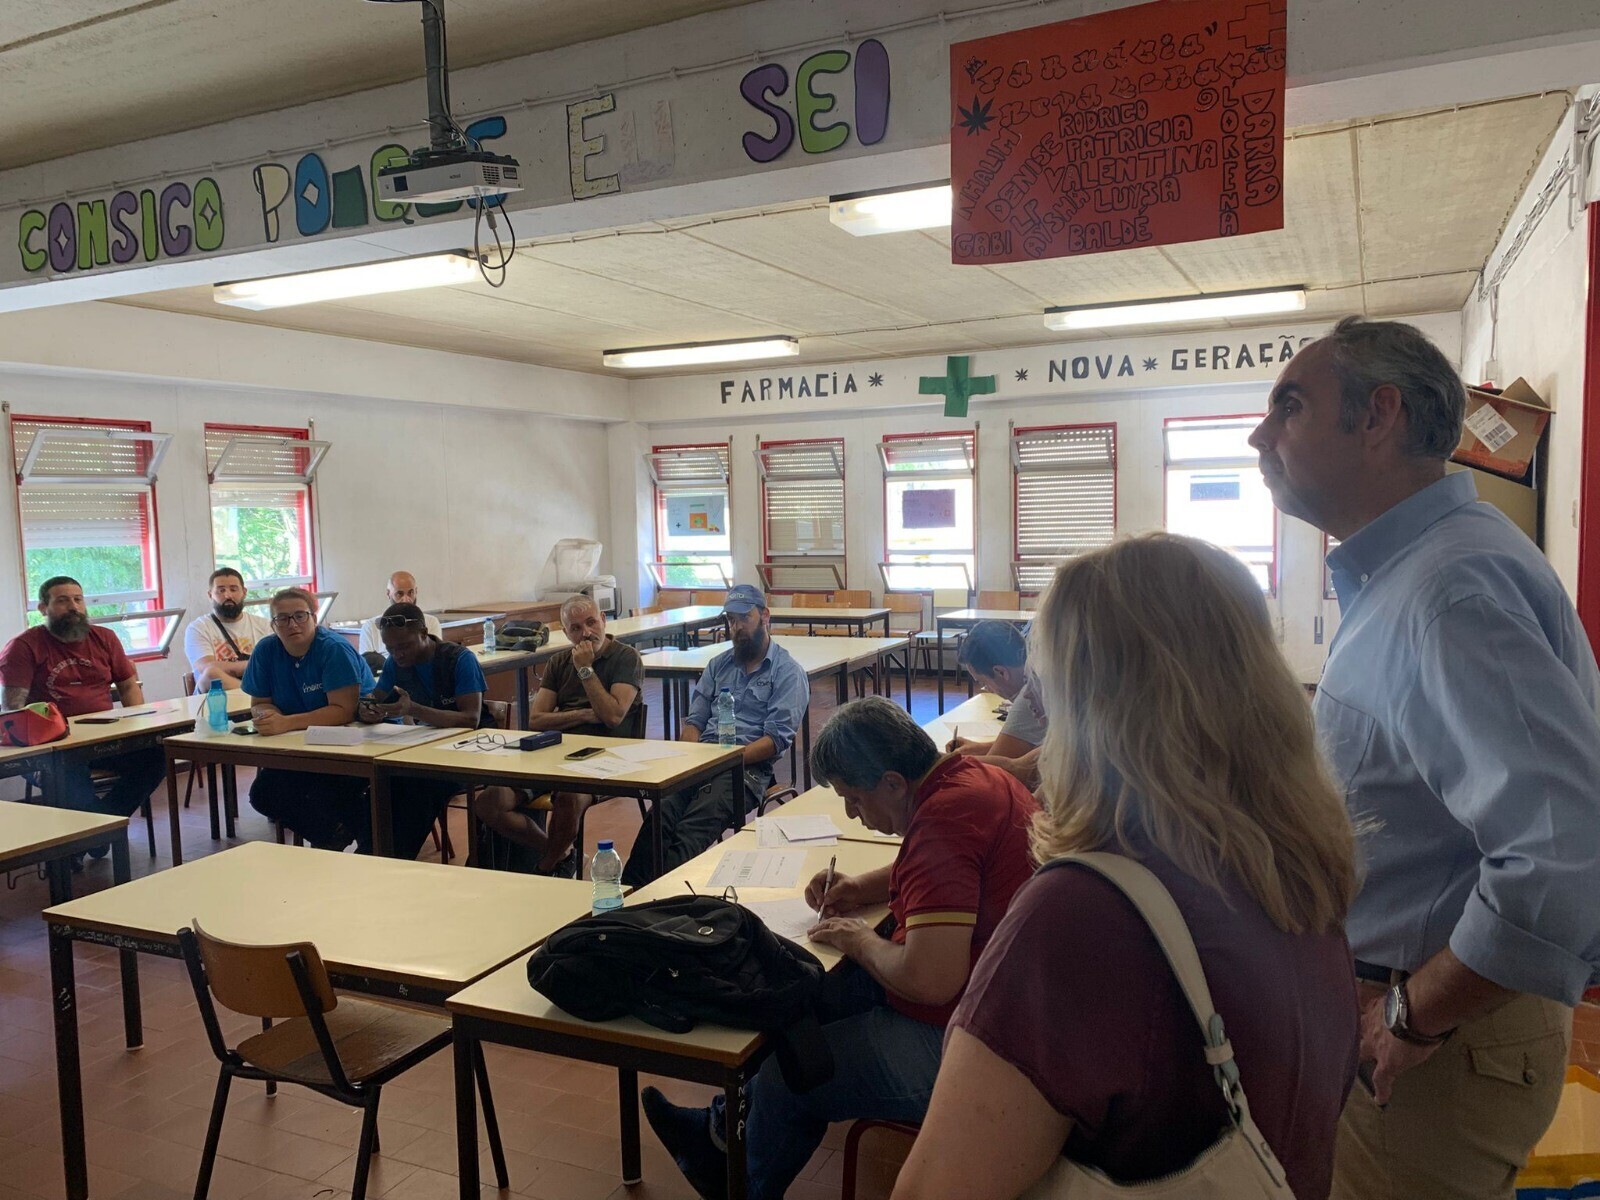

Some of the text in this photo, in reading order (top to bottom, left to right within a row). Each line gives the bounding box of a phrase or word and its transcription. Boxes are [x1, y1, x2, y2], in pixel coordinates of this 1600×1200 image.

[1058, 99, 1149, 138] RODRIGO
[1066, 114, 1193, 162] PATRICIA
[18, 177, 225, 272] CONSIGO
[740, 38, 891, 163] SEI
[985, 132, 1063, 223] DENISE
[1043, 139, 1218, 193] VALENTINA
[953, 230, 1012, 258] GABI
[1023, 190, 1090, 258] AYSHA
[1068, 204, 1152, 250] BALDÉ
[1049, 354, 1134, 382] NOVA
[1171, 335, 1314, 371] GERAÇÃ
